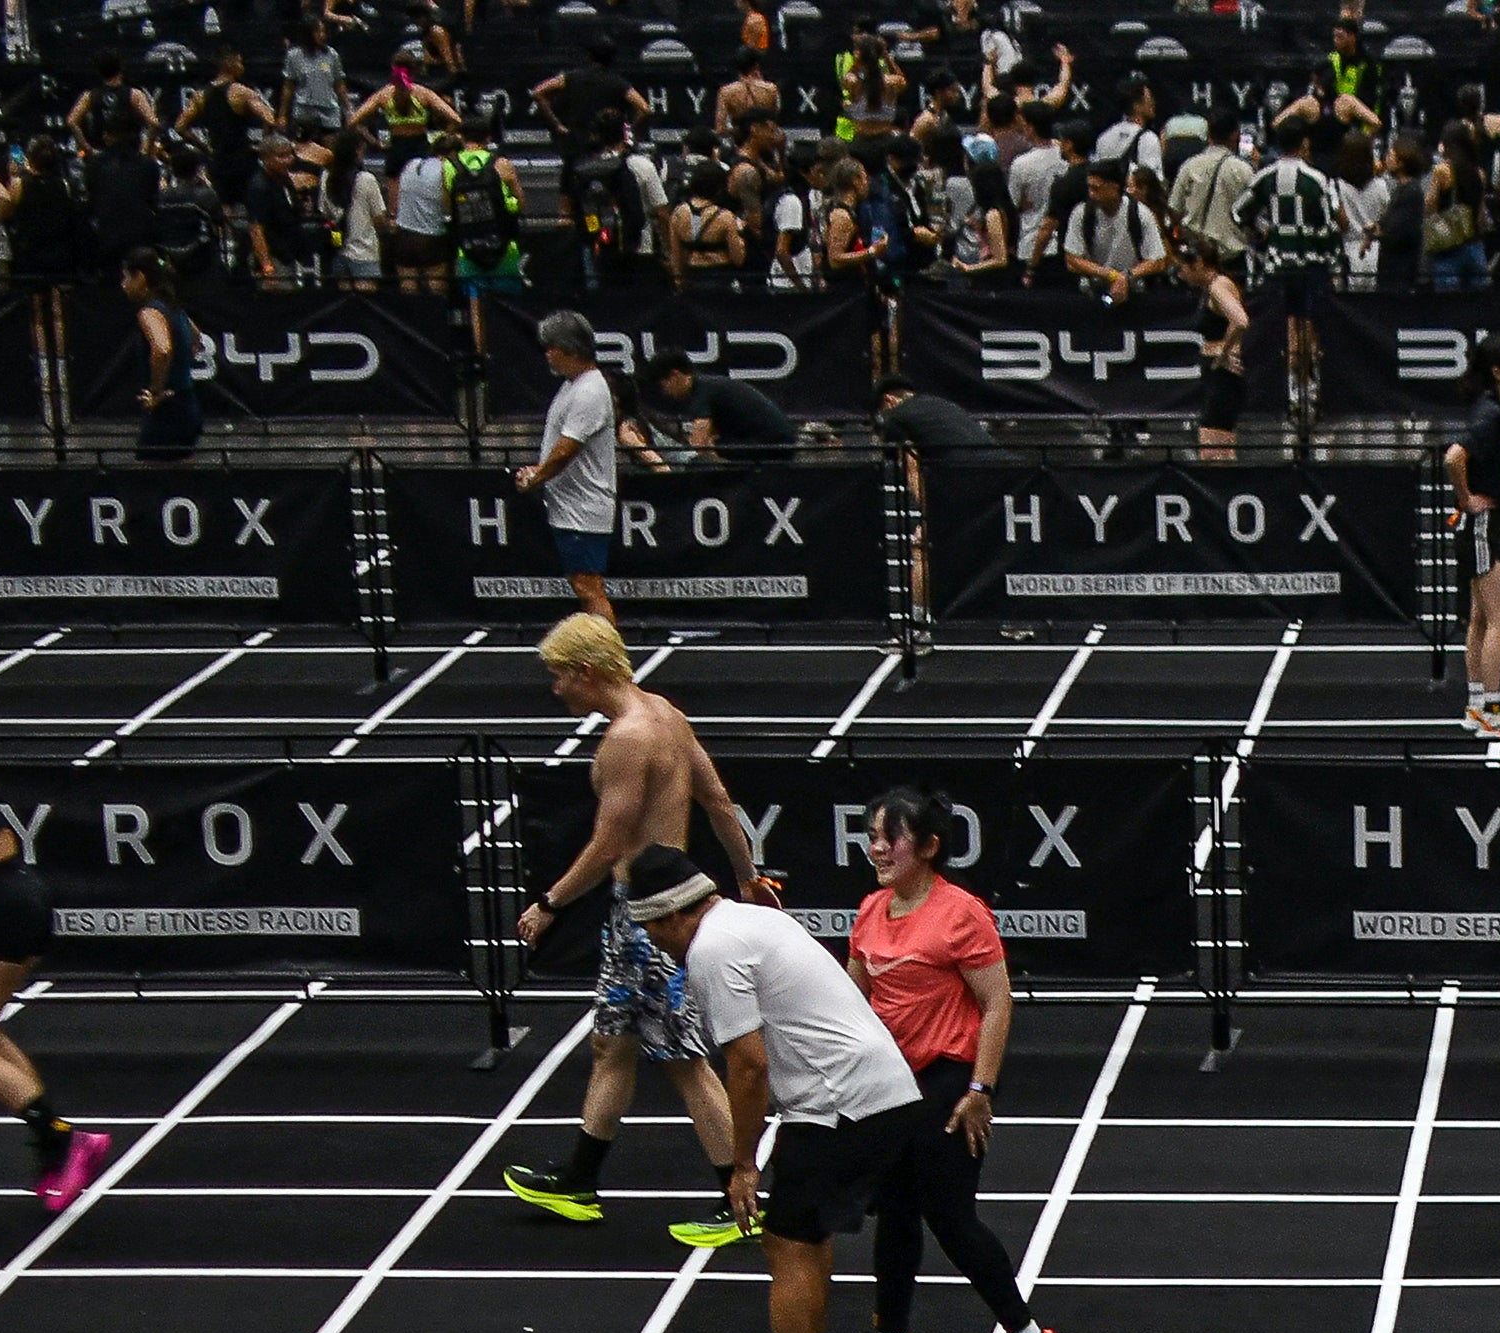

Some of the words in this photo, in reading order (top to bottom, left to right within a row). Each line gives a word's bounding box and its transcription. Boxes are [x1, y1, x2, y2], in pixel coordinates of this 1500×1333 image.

[981, 331, 1208, 381] BYD
[469, 497, 803, 547] HROX
[1004, 494, 1339, 543] HYROX
[22, 580, 86, 596] SERIES
[93, 580, 114, 595] OF
[122, 580, 197, 595] FITNESS
[205, 580, 274, 594] RACING
[1009, 578, 1074, 593] WORLD
[1082, 578, 1147, 593] SERIES
[1153, 577, 1174, 593] OF
[1182, 577, 1257, 592] FITNESS
[1265, 575, 1336, 591] RACING
[736, 802, 1081, 869] YROX
[104, 911, 135, 931] OF
[146, 911, 249, 931] FITNESS
[258, 911, 353, 931] RACING
[996, 914, 1080, 935] ACING
[1360, 916, 1447, 936] WORLD
